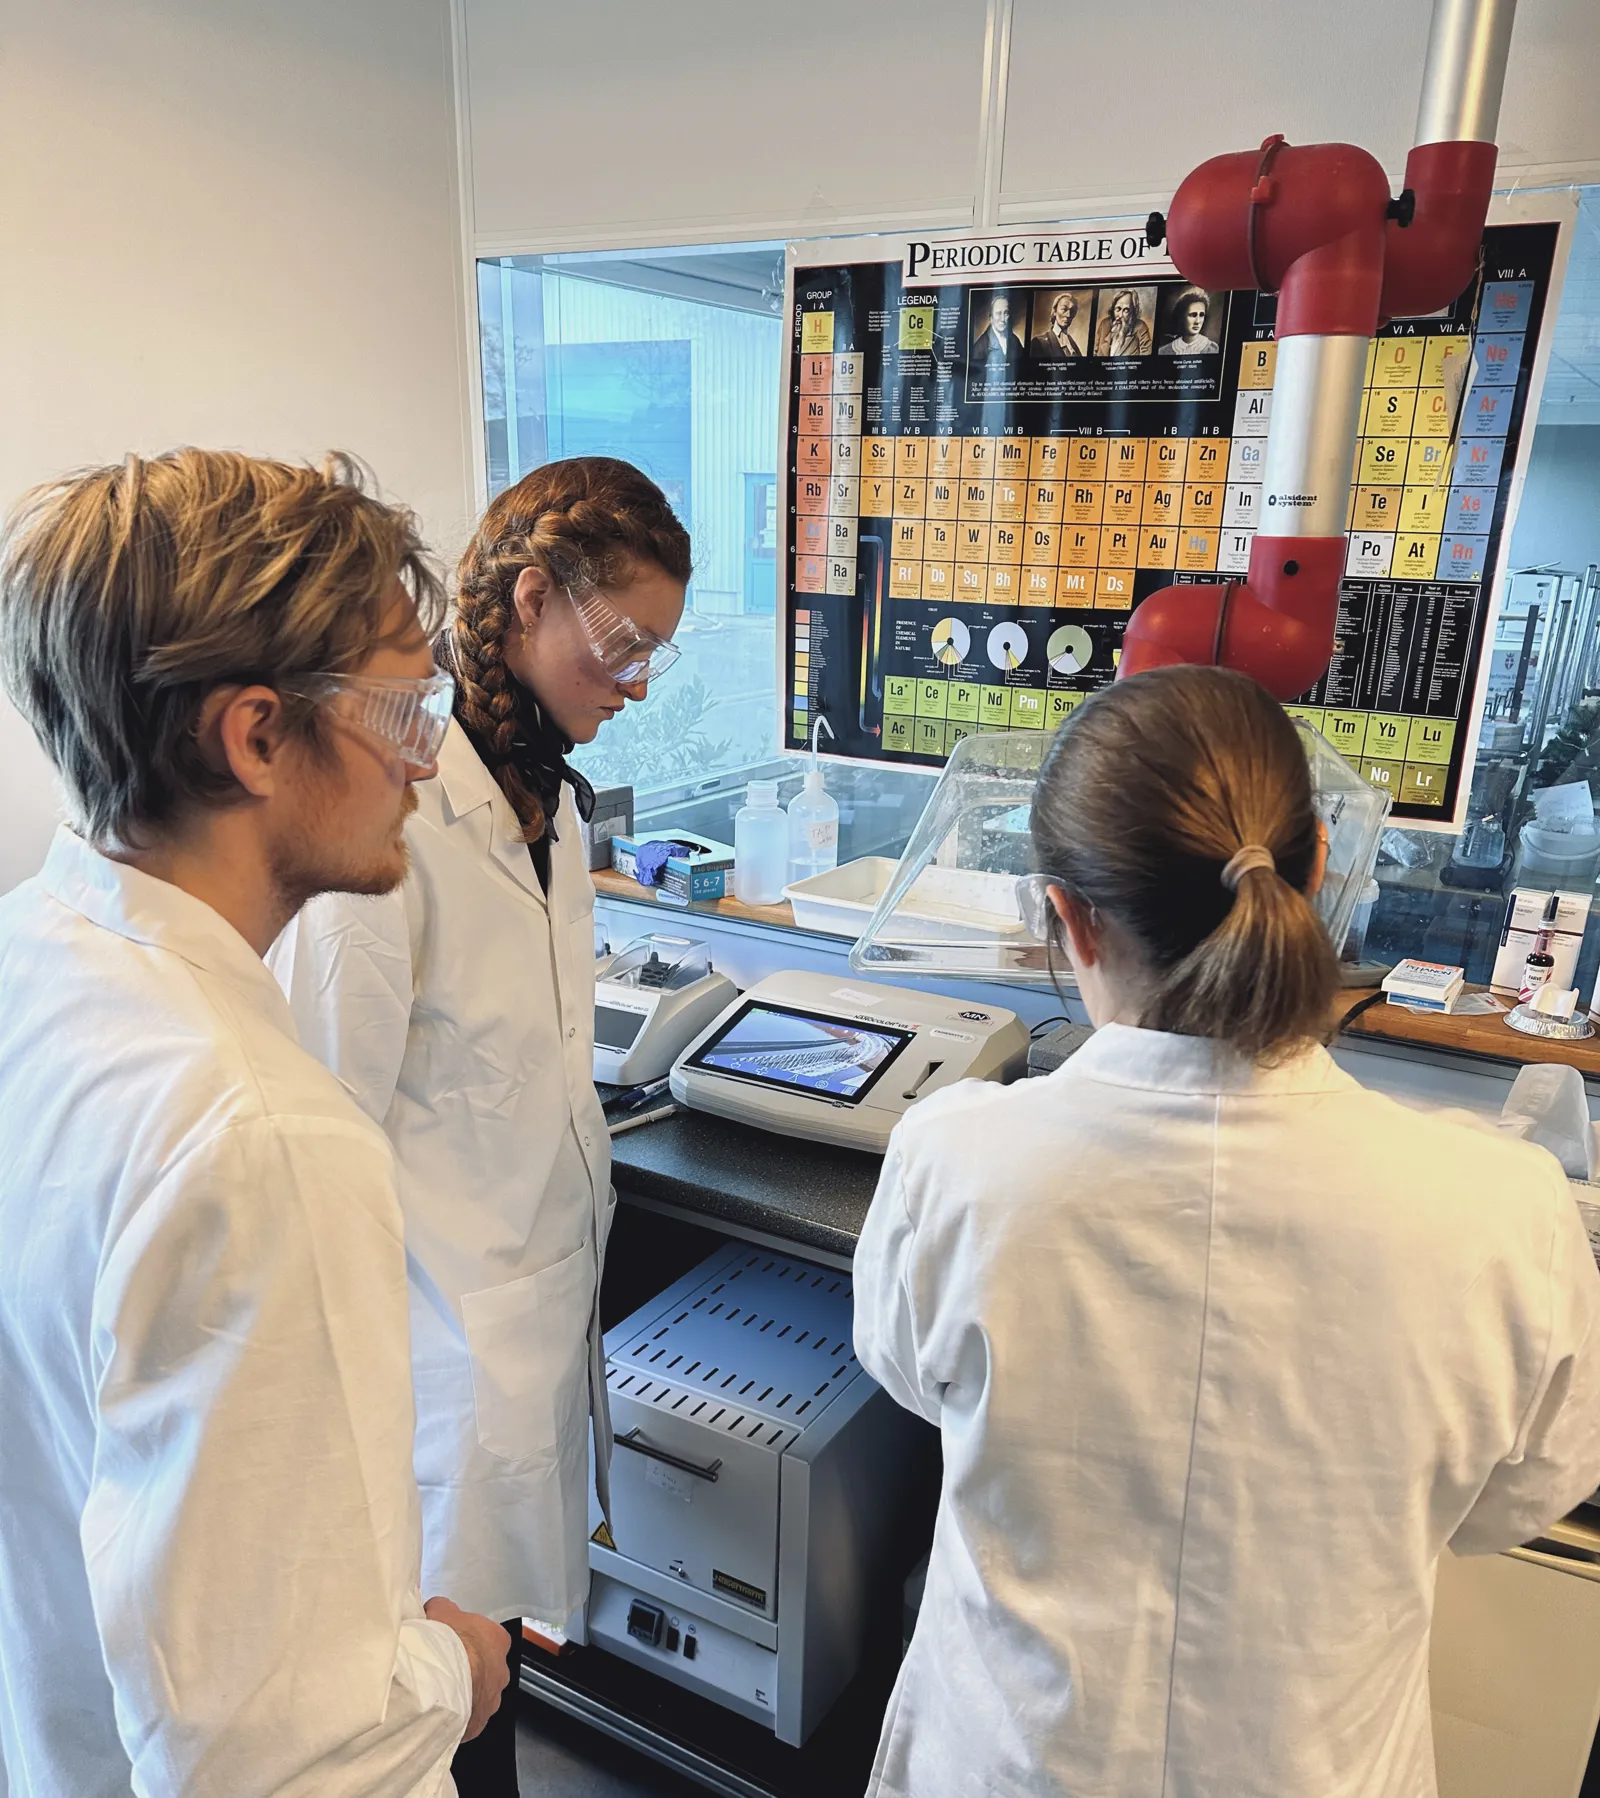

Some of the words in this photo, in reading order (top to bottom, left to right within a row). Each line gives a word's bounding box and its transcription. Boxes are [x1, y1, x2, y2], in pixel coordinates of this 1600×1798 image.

[906, 242, 1025, 278] PERIODIC
[1033, 239, 1113, 263] TABLE
[1120, 237, 1150, 258] OF
[1498, 269, 1514, 278] VIII
[1519, 268, 1527, 277] A
[807, 291, 832, 299] GROUP
[897, 296, 938, 305] LEGENDA
[819, 302, 825, 310] A
[814, 319, 822, 329] H
[909, 315, 923, 329] Ce
[1440, 324, 1452, 333] VII
[1457, 324, 1465, 332] A
[1268, 330, 1275, 338] A
[1393, 325, 1402, 334] VI
[1407, 325, 1415, 334] A
[849, 343, 855, 351] A
[1486, 345, 1508, 361] Ne
[1257, 351, 1267, 367] B
[812, 362, 822, 375] Li
[841, 361, 853, 374] Be
[809, 402, 823, 416] Na
[839, 403, 853, 418] Mg
[1249, 399, 1263, 414] Al
[1387, 396, 1397, 413] S
[1480, 395, 1498, 412] Ar
[1079, 427, 1092, 435] VIII
[1096, 427, 1103, 435] B
[1171, 427, 1178, 435] B
[1202, 427, 1208, 435] II
[1213, 427, 1219, 435] B
[810, 443, 818, 456] K
[838, 444, 850, 457] Ca
[872, 444, 885, 458] Sc
[905, 444, 916, 458] Ti
[941, 445, 948, 458] V
[973, 445, 985, 458] Cr
[1002, 445, 1021, 459] Mn
[1042, 445, 1057, 459] Fe
[1080, 445, 1096, 460] Co
[1120, 446, 1134, 460] Ni
[1159, 446, 1176, 461] Cu
[1199, 446, 1216, 461] Zn
[1241, 446, 1259, 461] Ga
[1375, 446, 1395, 462] Se
[1424, 446, 1441, 462] Br
[1470, 446, 1488, 463] Kr
[806, 483, 821, 496] Rb
[838, 484, 849, 497] Sr
[873, 484, 881, 497] Y
[903, 485, 915, 499] Zr
[935, 486, 949, 499] Nb
[967, 487, 985, 500] Mo
[1003, 488, 1015, 502] Tc
[1038, 488, 1053, 502] Ru
[1075, 489, 1093, 503] Rh
[1115, 489, 1132, 504] Pd
[1154, 490, 1171, 507] Ag
[1194, 491, 1212, 506] Cd
[1239, 491, 1252, 506] In
[1370, 494, 1387, 509] Te
[1460, 495, 1481, 511] Xe
[835, 524, 848, 537] Ba
[901, 527, 913, 540] Hf
[934, 528, 945, 541] Ta
[968, 529, 979, 543] W
[998, 530, 1014, 544] Re
[1034, 531, 1050, 545] Os
[1075, 533, 1085, 546] Ir
[1113, 533, 1127, 548] Pt
[1149, 536, 1166, 549] Au
[1189, 536, 1207, 553] Hg
[1361, 541, 1380, 556] Po
[1408, 543, 1424, 558] At
[834, 564, 847, 577] Ra
[898, 567, 912, 580] Rf
[932, 568, 945, 583] Db
[963, 570, 978, 587] Sg
[995, 572, 1010, 586] Bh
[1031, 574, 1047, 589] Hs
[1066, 575, 1085, 590] Mt
[1107, 576, 1123, 591] Ds
[925, 685, 938, 699] Ce
[958, 689, 970, 702] Pr
[988, 692, 1002, 706] Nd
[1019, 695, 1037, 709] Pm
[1054, 698, 1074, 712] Sm
[891, 722, 905, 735] Ac
[923, 724, 936, 738] Th
[1334, 719, 1355, 733] Tm
[1379, 722, 1396, 738] Yb
[1423, 726, 1441, 742] Lu
[1370, 767, 1390, 783] No
[1416, 771, 1433, 787] Lr
[694, 879, 700, 889] S
[703, 876, 720, 887] 6-7
[963, 1012, 986, 1021] MN
